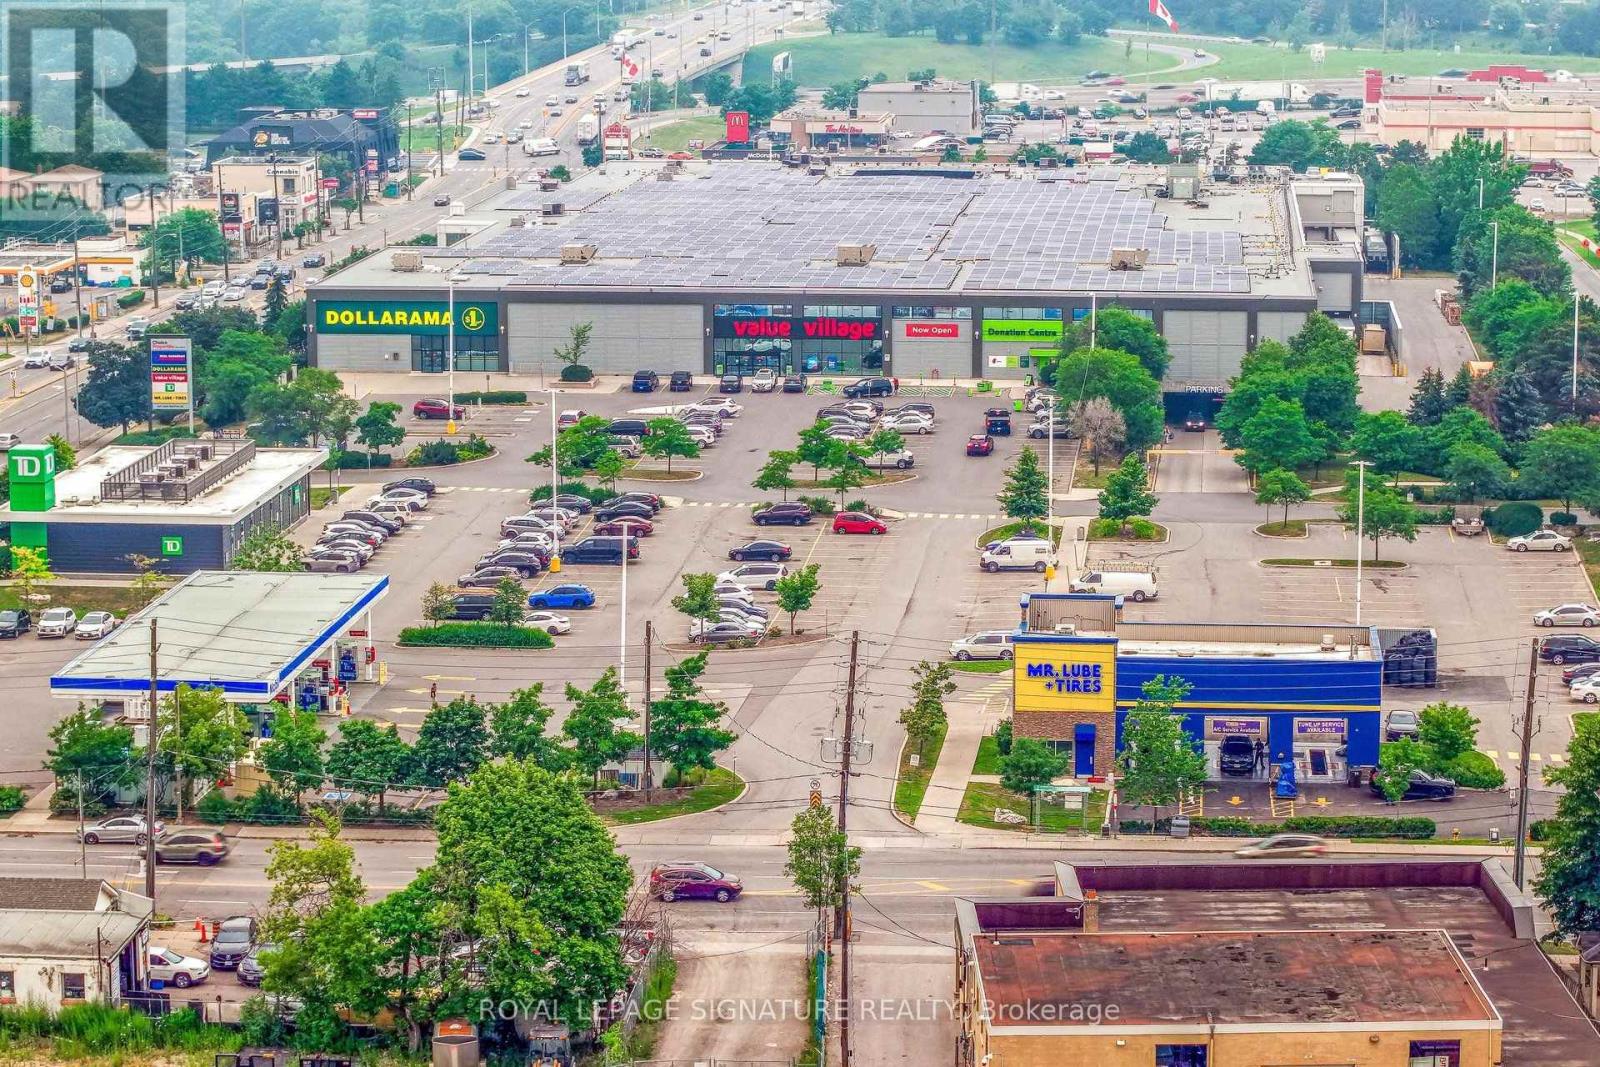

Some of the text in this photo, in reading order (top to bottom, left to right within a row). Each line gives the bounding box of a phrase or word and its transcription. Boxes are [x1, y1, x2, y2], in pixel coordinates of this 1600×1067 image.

[325, 310, 454, 326] DOLLARAMA
[733, 316, 876, 341] value village
[912, 326, 953, 335] Now Open
[988, 327, 1058, 337] Donation Centre
[1185, 385, 1224, 394] PARKING
[11, 455, 41, 477] TD
[165, 539, 181, 552] TD
[1027, 663, 1102, 678] MR. LUBE
